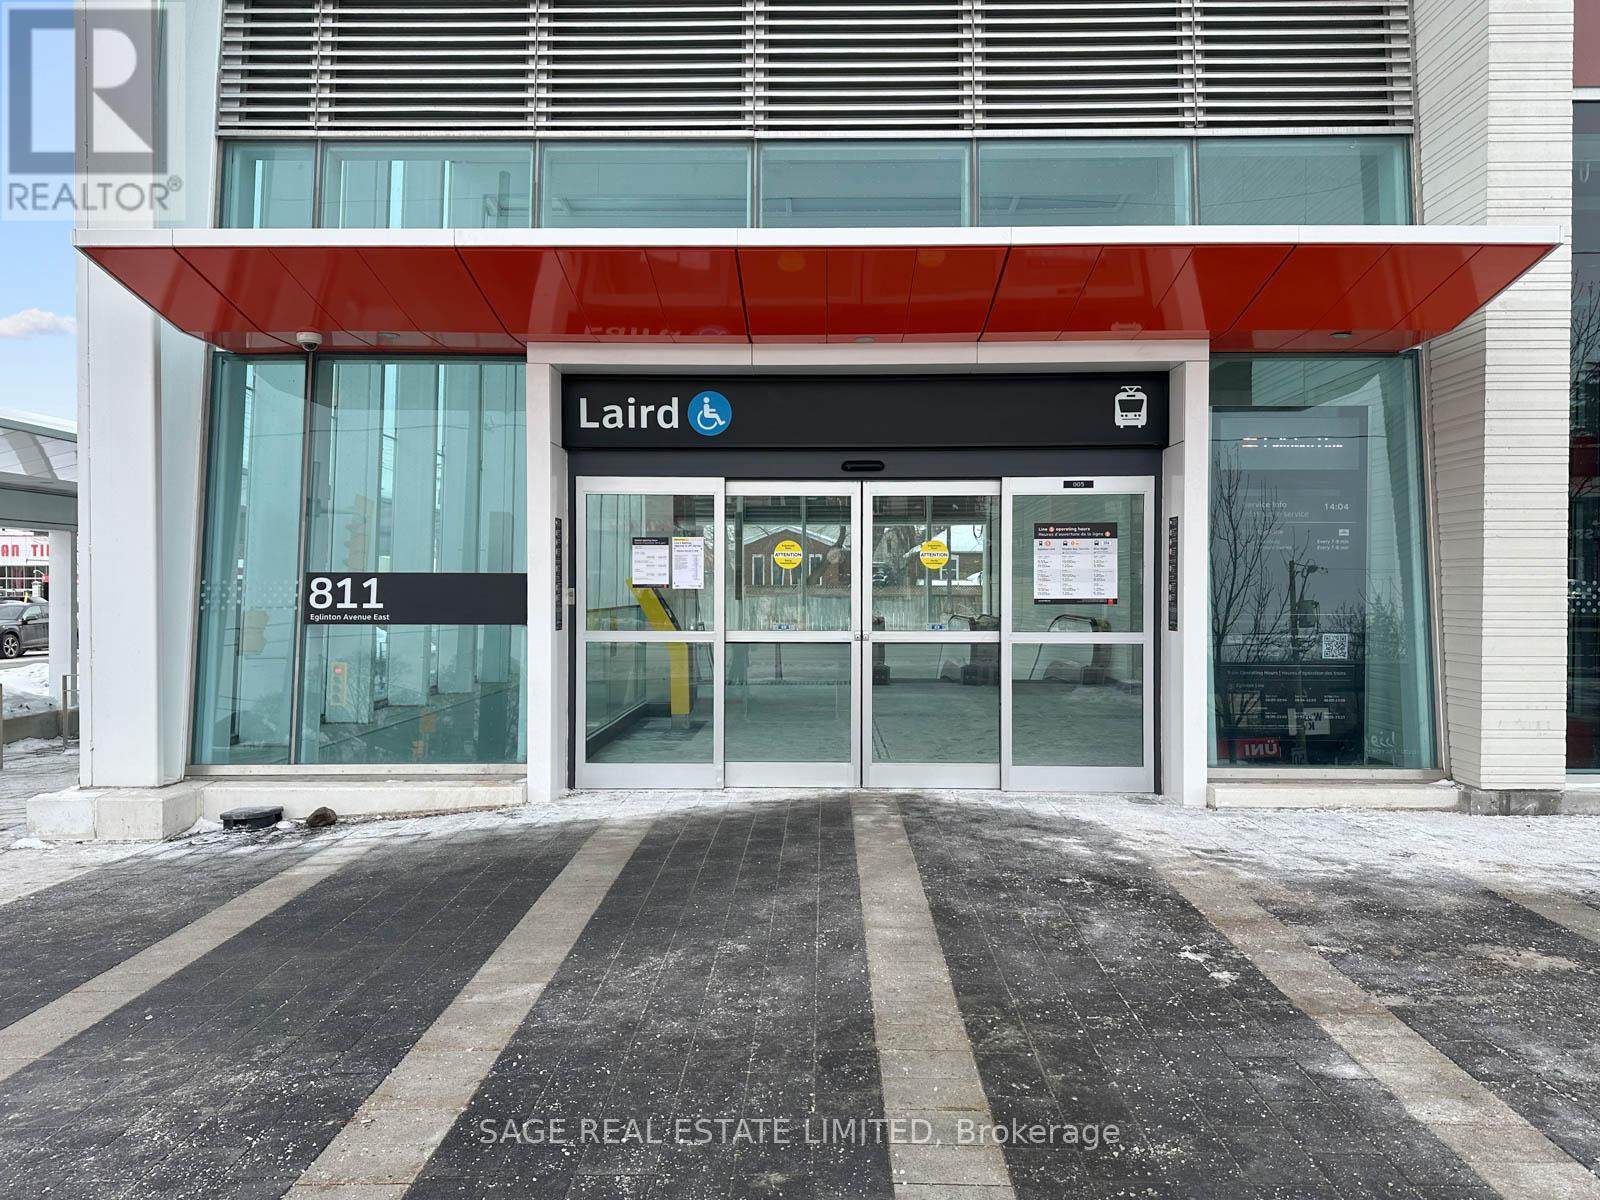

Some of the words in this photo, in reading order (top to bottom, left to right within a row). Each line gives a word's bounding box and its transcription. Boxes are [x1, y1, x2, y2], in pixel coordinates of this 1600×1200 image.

[579, 396, 679, 429] Laird
[1324, 503, 1349, 511] 14:04
[309, 577, 384, 609] 811
[310, 613, 342, 622] Eglinton
